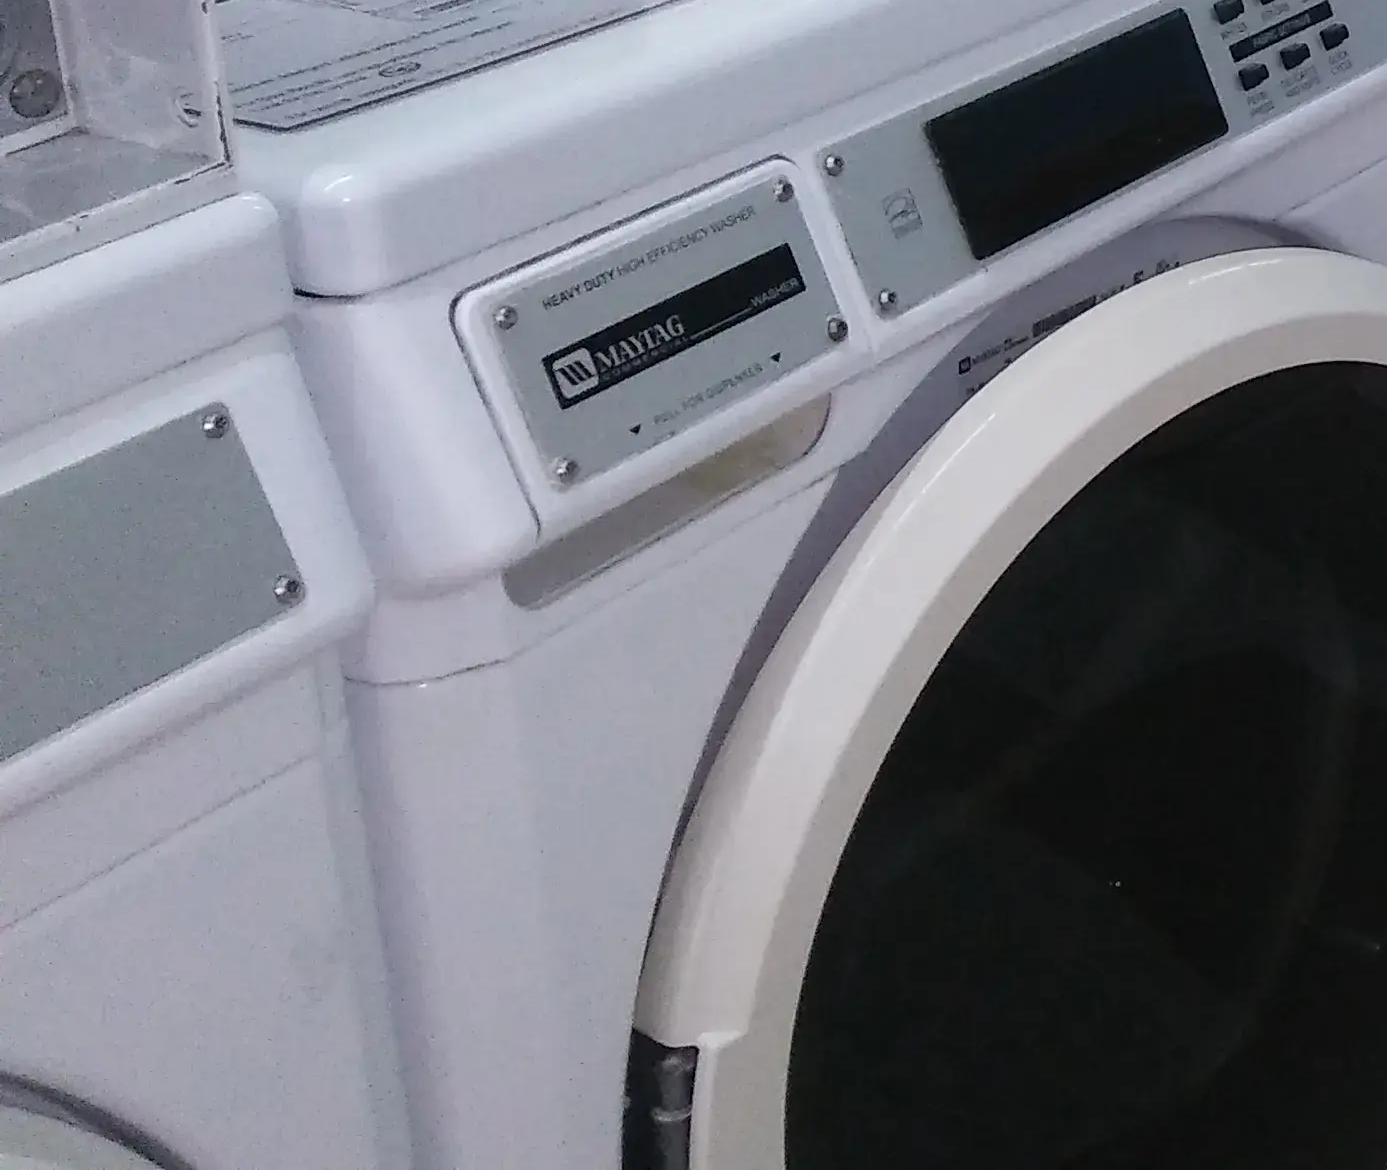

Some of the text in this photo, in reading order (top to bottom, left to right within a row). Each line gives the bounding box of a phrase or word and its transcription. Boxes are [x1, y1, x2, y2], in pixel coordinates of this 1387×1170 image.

[542, 284, 581, 311] HEAVY
[583, 270, 617, 294] DUTY
[617, 255, 646, 279] HIGH
[646, 227, 710, 267] EFFICIENCY
[750, 276, 800, 310] WASHER
[594, 314, 685, 374] MAYTAG
